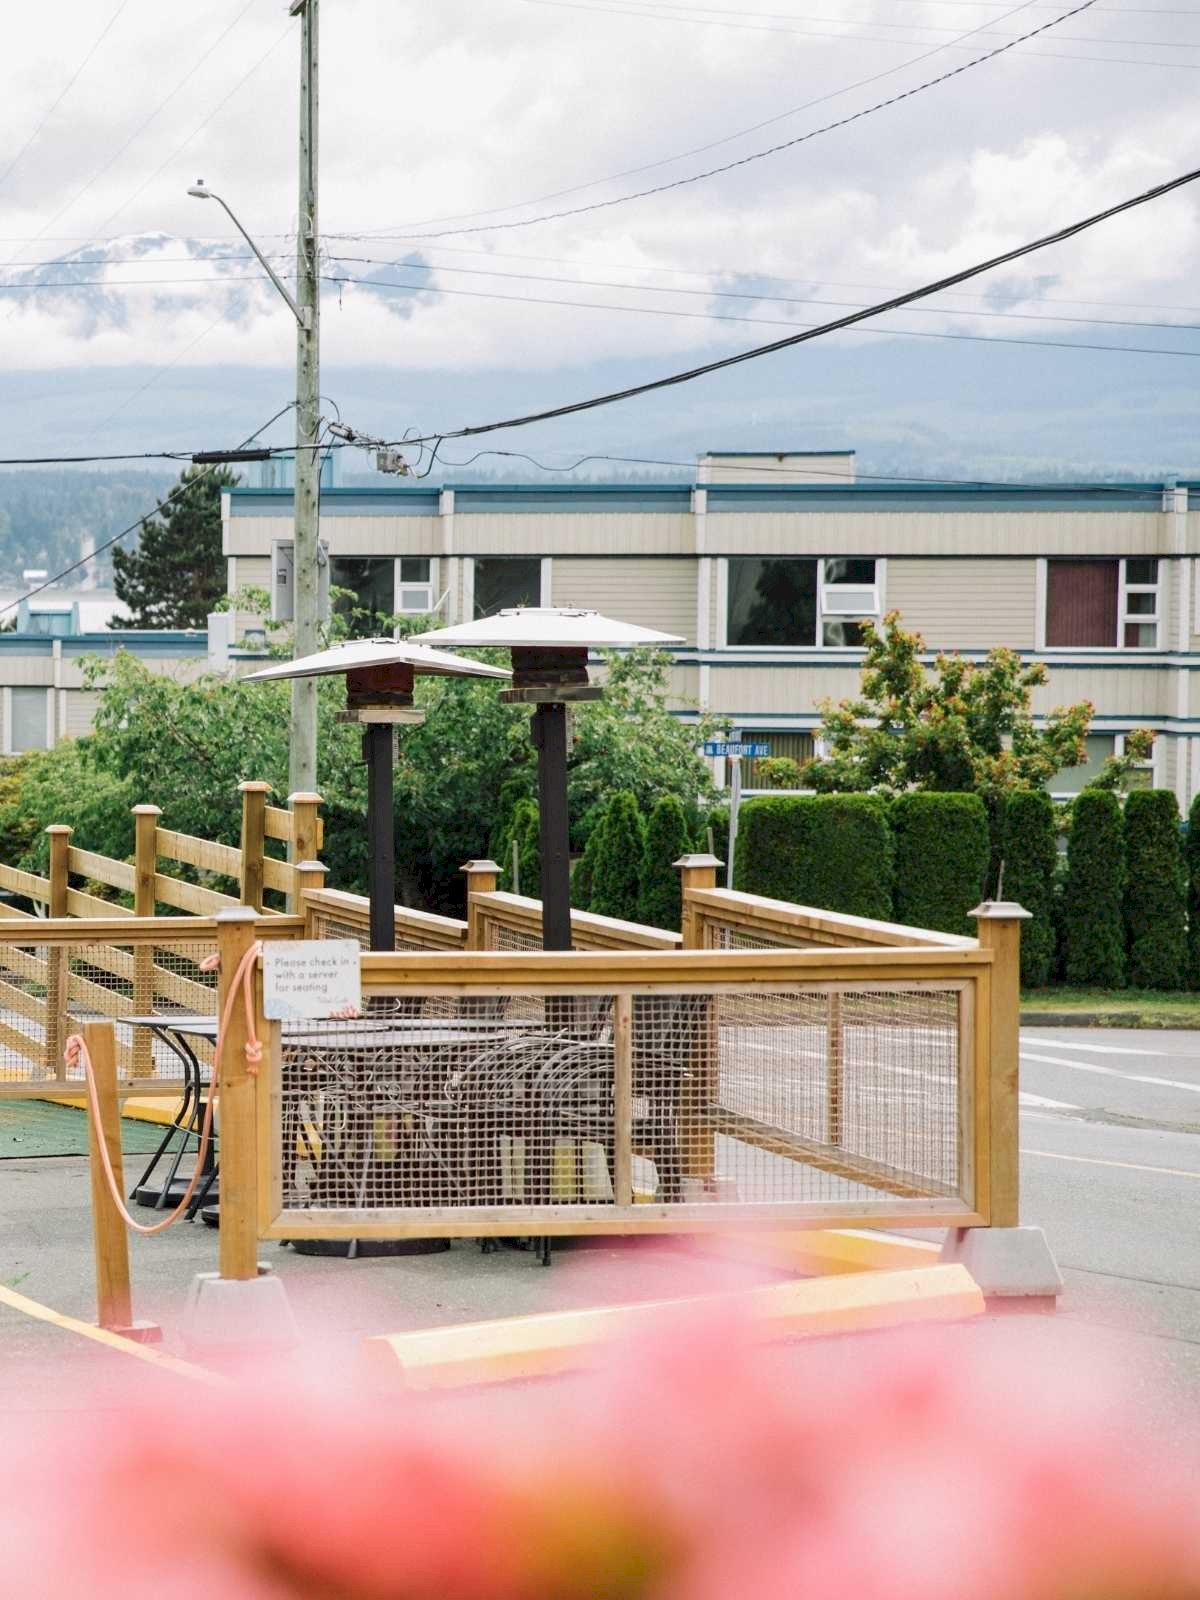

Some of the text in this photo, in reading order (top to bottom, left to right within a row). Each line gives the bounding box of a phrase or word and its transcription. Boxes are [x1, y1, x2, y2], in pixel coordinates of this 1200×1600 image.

[754, 745, 769, 756] AVE
[274, 956, 350, 967] Please check in
[275, 970, 296, 980] with
[308, 971, 338, 979] server
[275, 982, 329, 994] for seating
